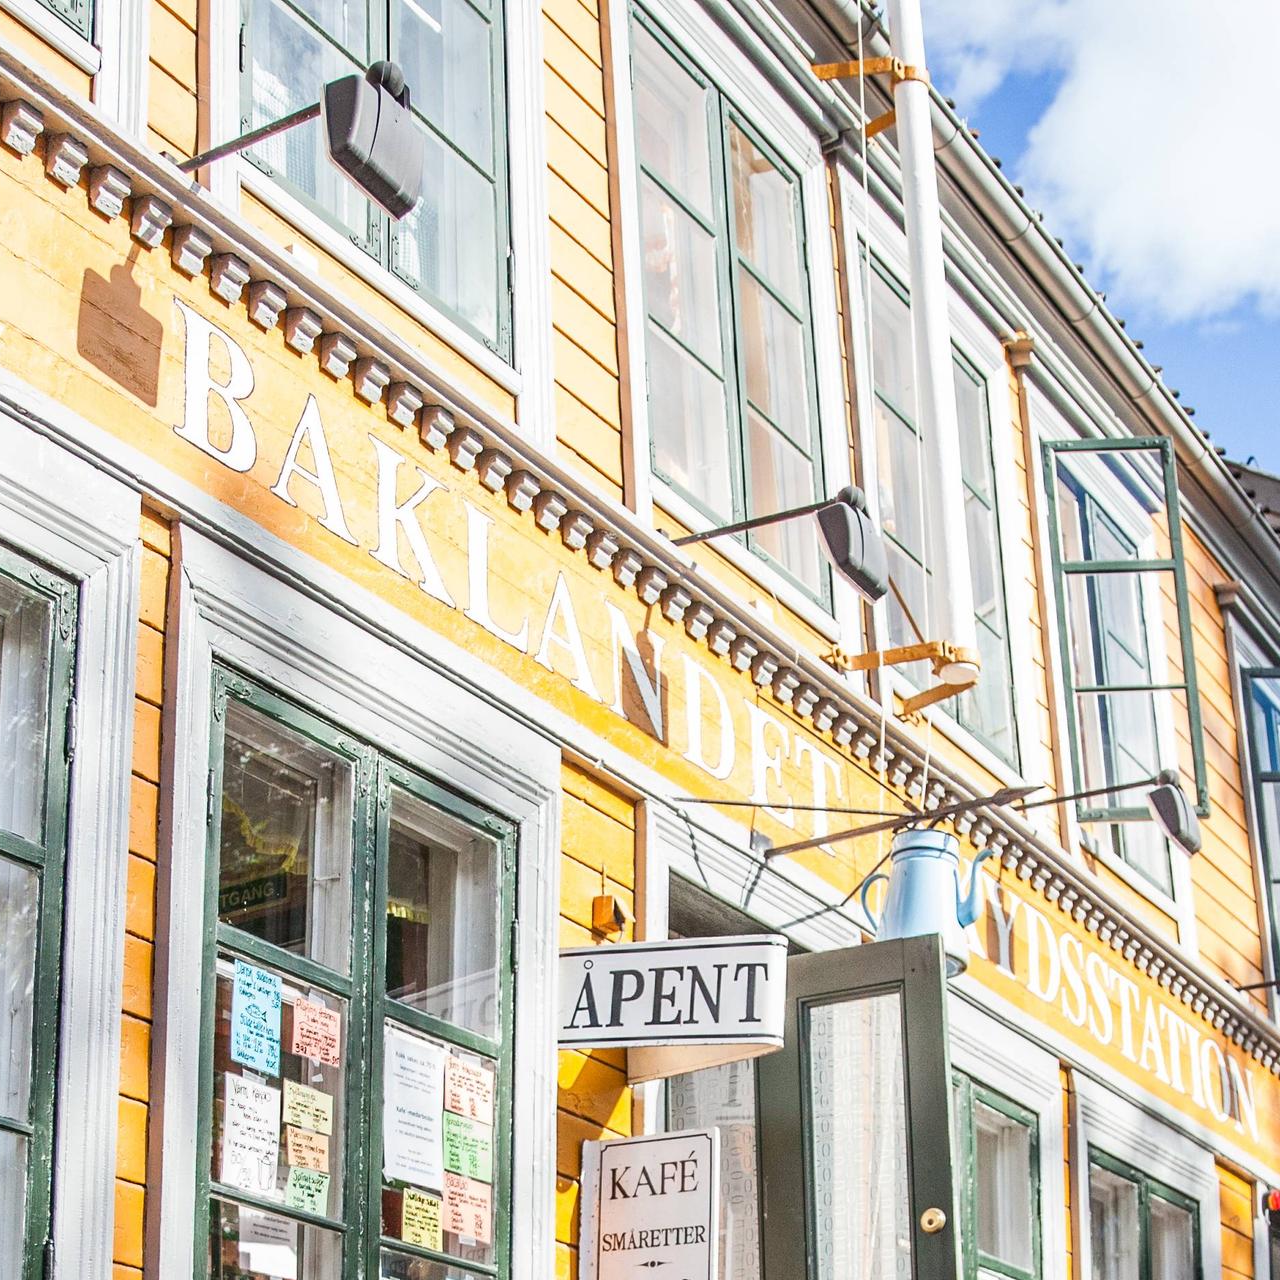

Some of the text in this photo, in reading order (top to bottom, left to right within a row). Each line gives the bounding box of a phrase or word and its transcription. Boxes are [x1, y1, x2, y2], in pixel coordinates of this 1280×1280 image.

[173, 297, 848, 857] BAKLANDET
[219, 882, 274, 908] TGANG
[563, 960, 769, 1030] ÅPENT
[609, 1152, 699, 1201] KAFÉ
[602, 1225, 707, 1253] SMÅRETTER
